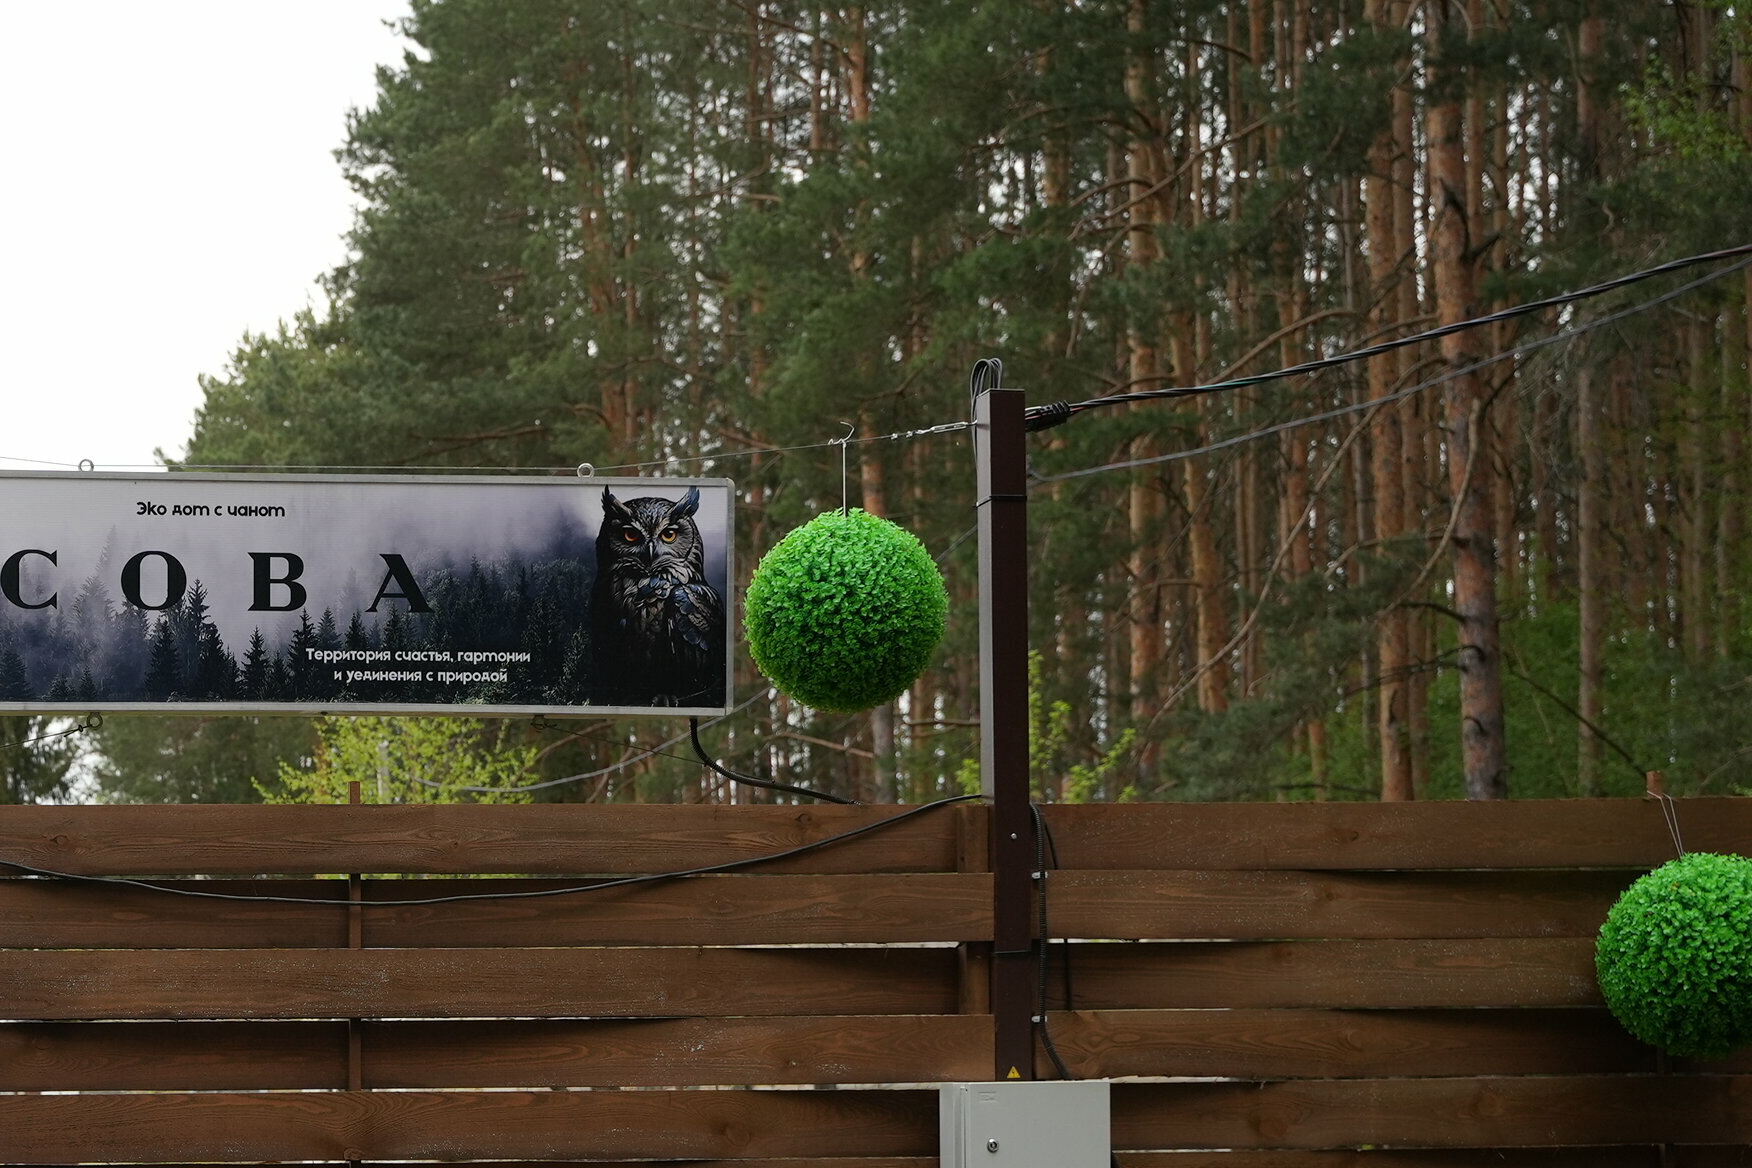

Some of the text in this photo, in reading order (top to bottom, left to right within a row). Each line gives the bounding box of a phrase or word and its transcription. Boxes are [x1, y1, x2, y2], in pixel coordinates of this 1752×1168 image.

[136, 501, 167, 516] Эко
[214, 505, 223, 516] с
[0, 549, 435, 613] СОВА
[305, 648, 531, 664] Территория счастья, гармонии
[334, 669, 508, 685] и уединения с природой
